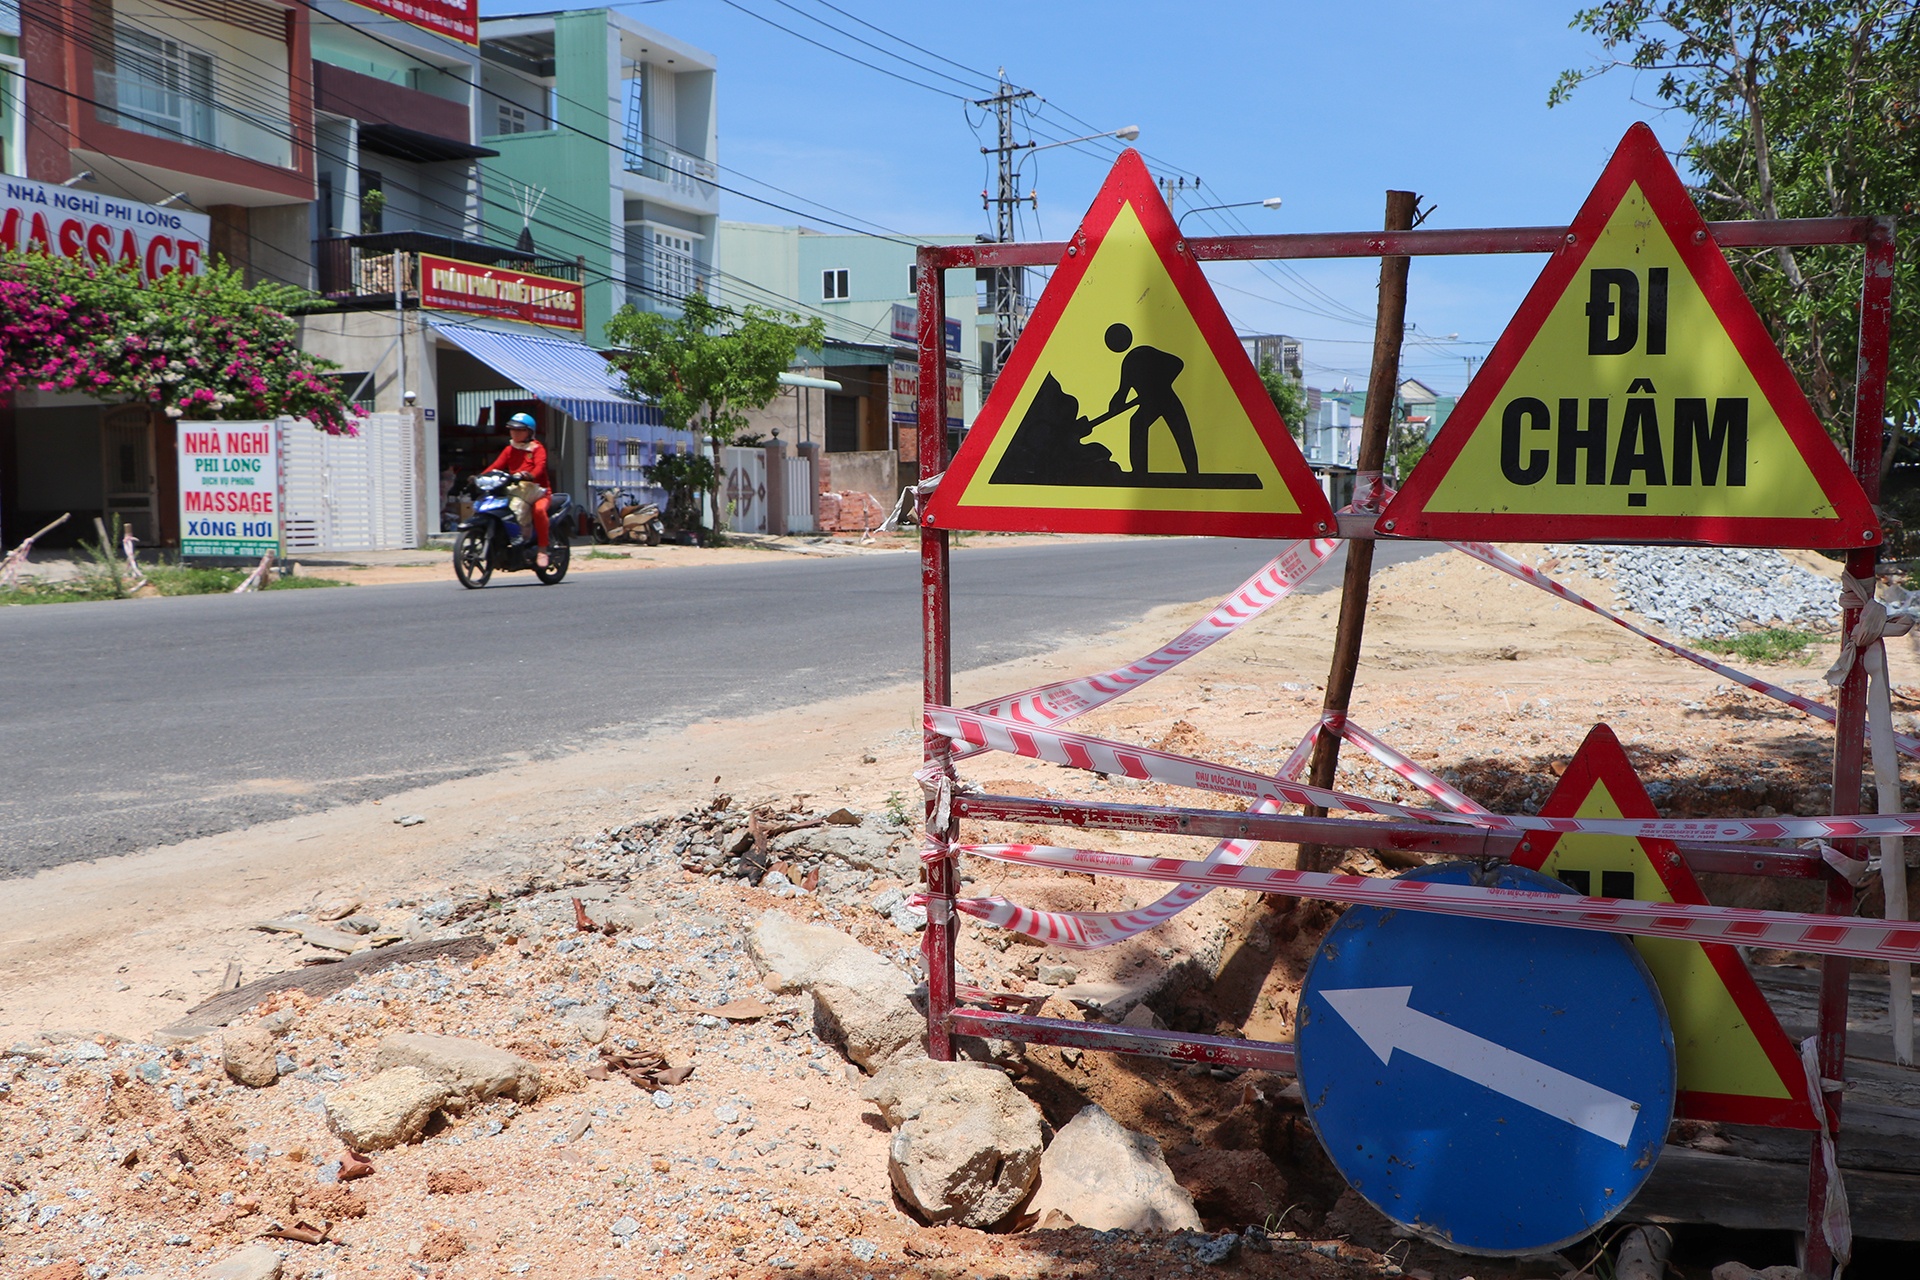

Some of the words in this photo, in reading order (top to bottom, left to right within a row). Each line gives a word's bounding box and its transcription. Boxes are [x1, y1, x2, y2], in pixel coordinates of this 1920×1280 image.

[7, 183, 48, 205] NHÀ
[105, 203, 132, 221] PHI
[137, 208, 182, 229] LONG
[1585, 267, 1669, 355] ĐI
[894, 377, 916, 396] KIM
[185, 427, 222, 454] NHÀ
[226, 424, 269, 454] NGHỈ
[1500, 378, 1749, 507] CHẬM
[195, 458, 219, 472] PHI
[223, 458, 261, 473] LONG
[185, 491, 273, 513] MASSAGE
[188, 518, 236, 537] XÔNG
[243, 521, 272, 538] HƠI
